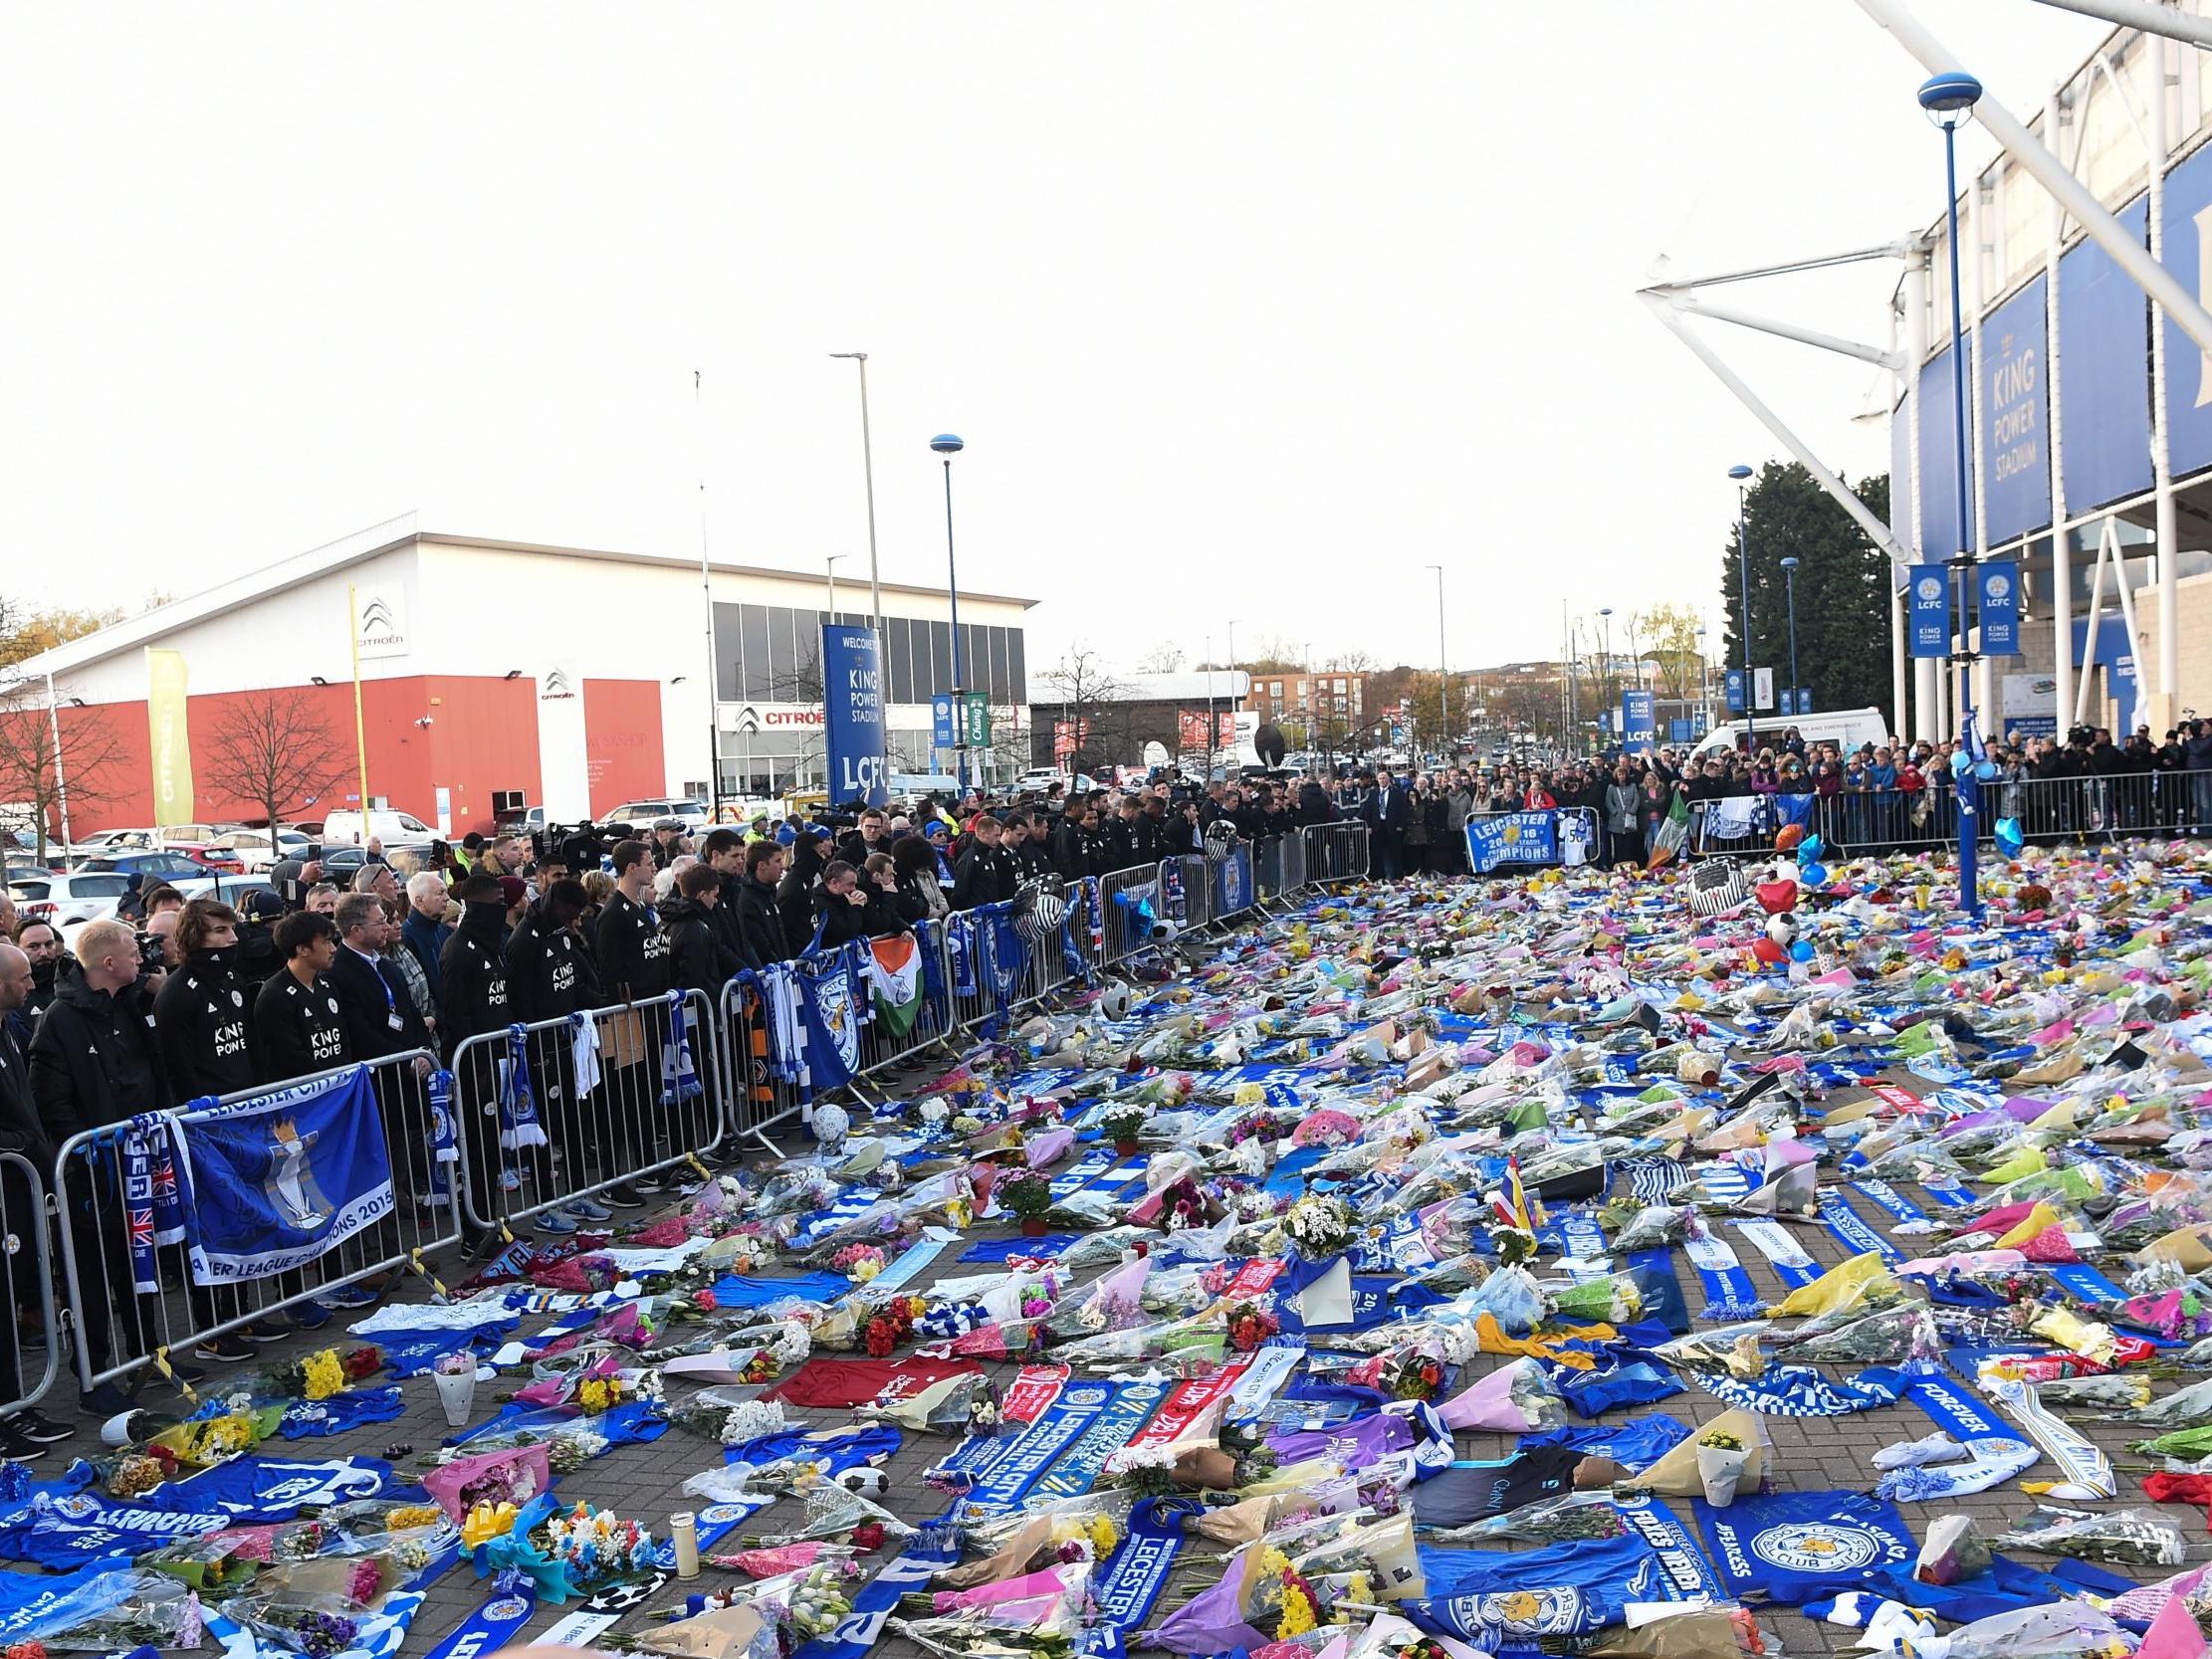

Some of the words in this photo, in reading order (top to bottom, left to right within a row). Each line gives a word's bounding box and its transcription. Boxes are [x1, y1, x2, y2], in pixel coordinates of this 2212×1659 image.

[1993, 348, 2036, 411] KING
[1994, 399, 2036, 449] POWER
[1995, 440, 2037, 482] STADIUM
[1917, 600, 1942, 610] LCFC
[1986, 597, 2010, 607] LCFC
[842, 636, 873, 651] WELCOME
[849, 668, 877, 691] KING
[850, 692, 878, 708] POWER
[766, 707, 825, 726] CITROË
[851, 709, 879, 724] STADIUM
[972, 706, 983, 742] Chang
[1627, 731, 1653, 742] LCFC
[842, 755, 886, 791] LCFC
[1473, 813, 1548, 840] LEICESTER
[1488, 836, 1503, 850] 20
[1522, 827, 1537, 839] 16
[1480, 846, 1550, 871] CHAMPIONS
[553, 961, 574, 982] KING
[553, 975, 574, 992] POWER
[489, 979, 507, 994] KIN
[214, 1021, 244, 1043] KING
[311, 1028, 340, 1048] KING
[207, 1090, 295, 1118] LEICESTER
[235, 1254, 292, 1277] LEAGUE
[356, 1189, 394, 1221] 2015
[1915, 1381, 1991, 1434] FOREVER
[1003, 1420, 1055, 1462] FOOTBALL
[1010, 1411, 1092, 1472] LEICESTER
[1080, 1421, 1130, 1470] LEICESTER
[979, 1463, 1011, 1488] CLUB
[986, 1473, 1029, 1503] CITY
[93, 1508, 232, 1535] LEICESTER
[1627, 1510, 1675, 1549] FOXES
[1658, 1550, 1702, 1592] NEVER
[1777, 1554, 1821, 1568] CLUB
[1105, 1538, 1164, 1616] LEICESTER
